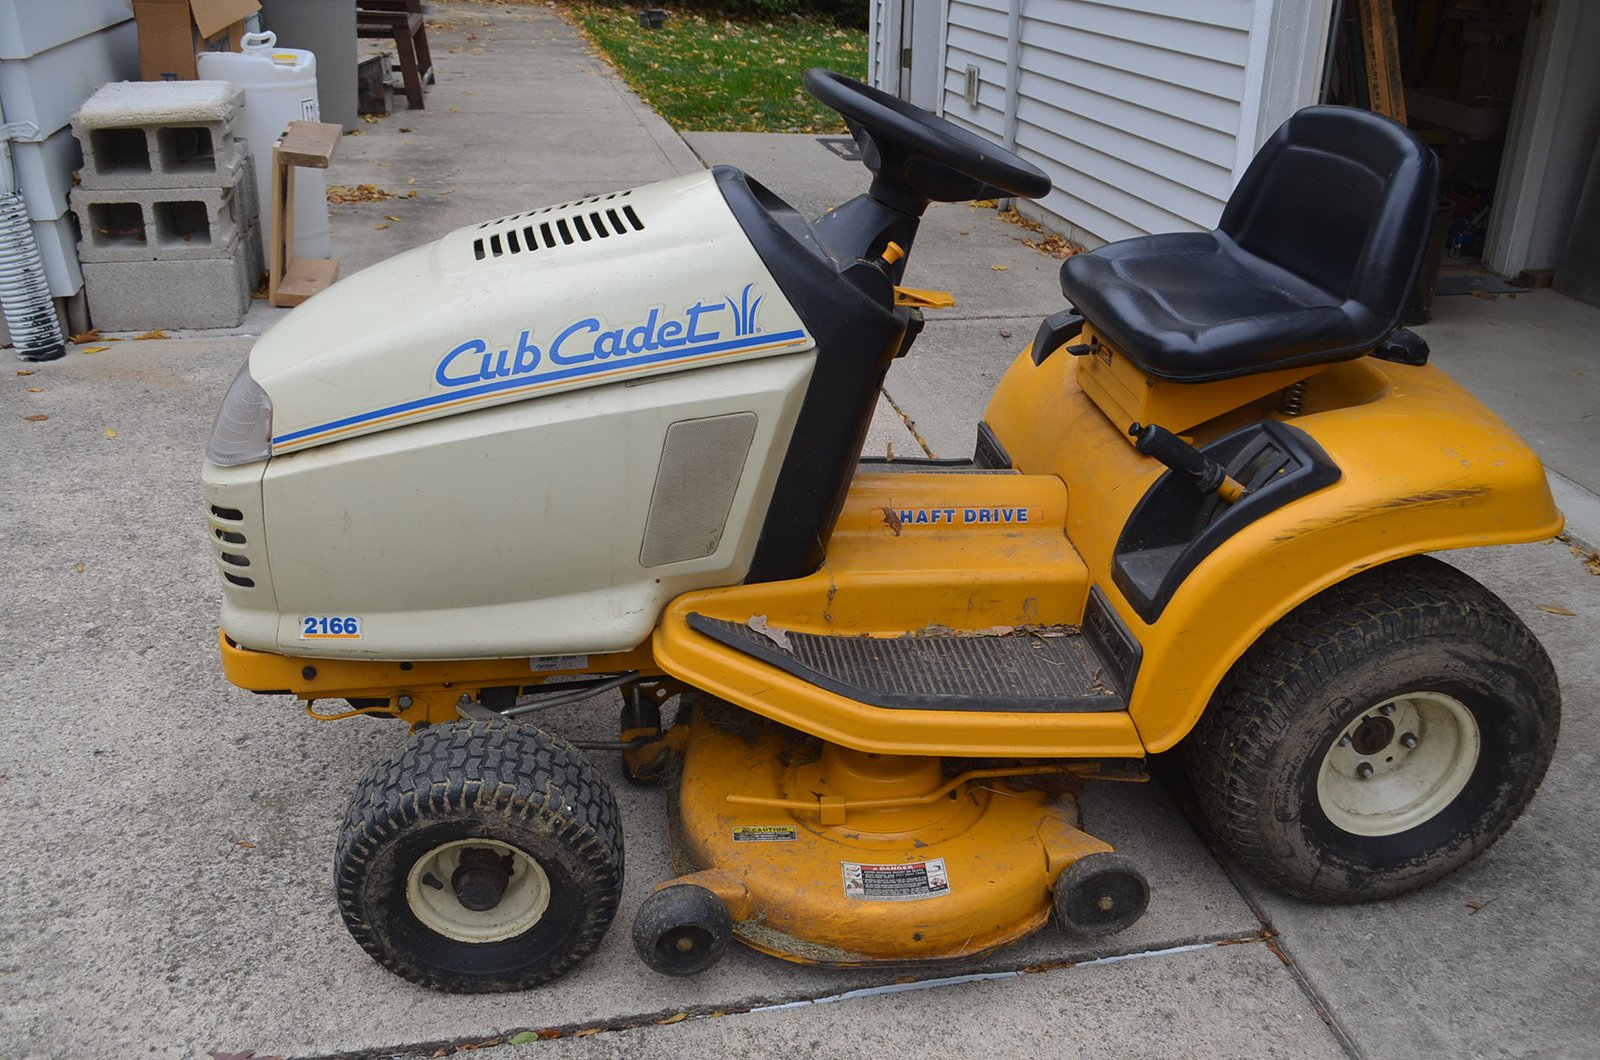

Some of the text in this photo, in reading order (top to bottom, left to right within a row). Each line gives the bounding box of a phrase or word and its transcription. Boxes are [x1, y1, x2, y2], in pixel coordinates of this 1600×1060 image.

[435, 301, 726, 387] Cub Cadet
[893, 508, 1029, 524] HAFT DRIVE
[304, 617, 358, 635] 2166
